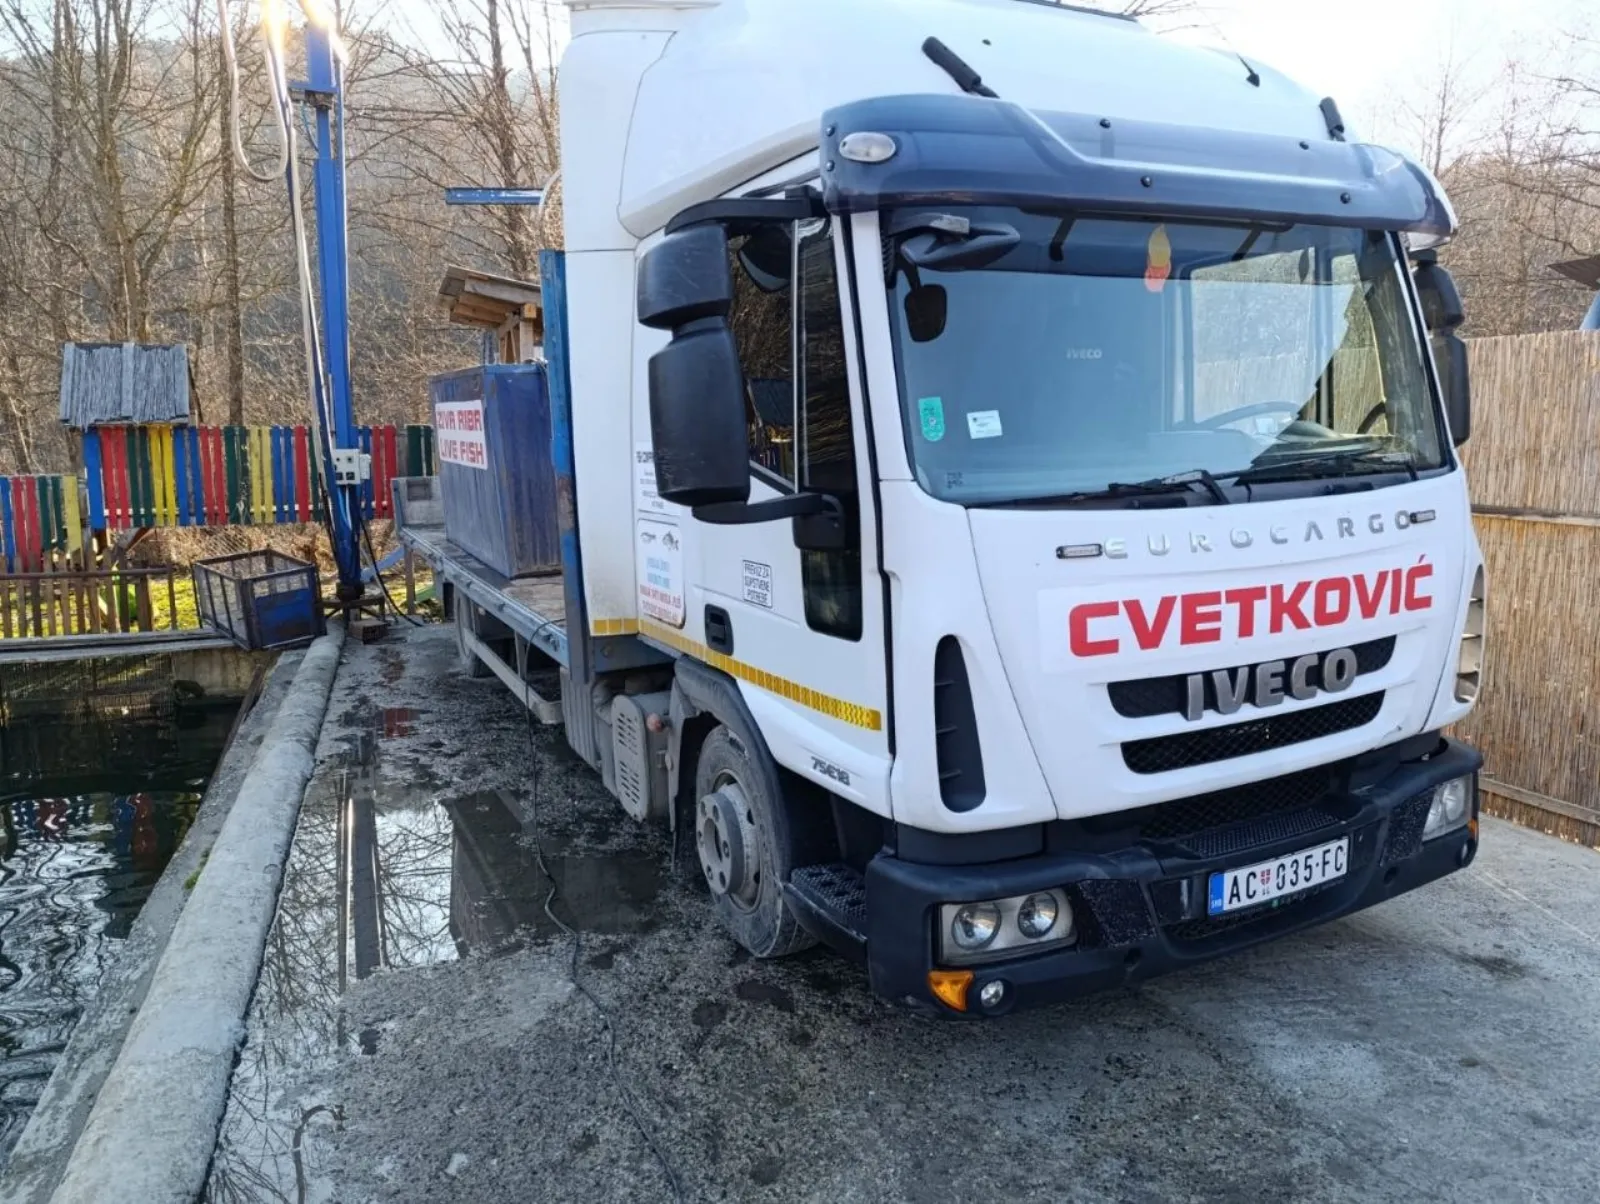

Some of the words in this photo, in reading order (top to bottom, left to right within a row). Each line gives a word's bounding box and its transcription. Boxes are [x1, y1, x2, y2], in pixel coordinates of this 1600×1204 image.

[1066, 348, 1103, 360] IVECO
[457, 409, 482, 431] RIBA
[440, 438, 459, 460] LIVE
[460, 441, 485, 465] FISH
[1103, 509, 1412, 560] EUROCARGO
[1069, 554, 1434, 658] CVETKOVIĆ
[1186, 647, 1359, 722] IVECO
[1228, 871, 1257, 904] AC
